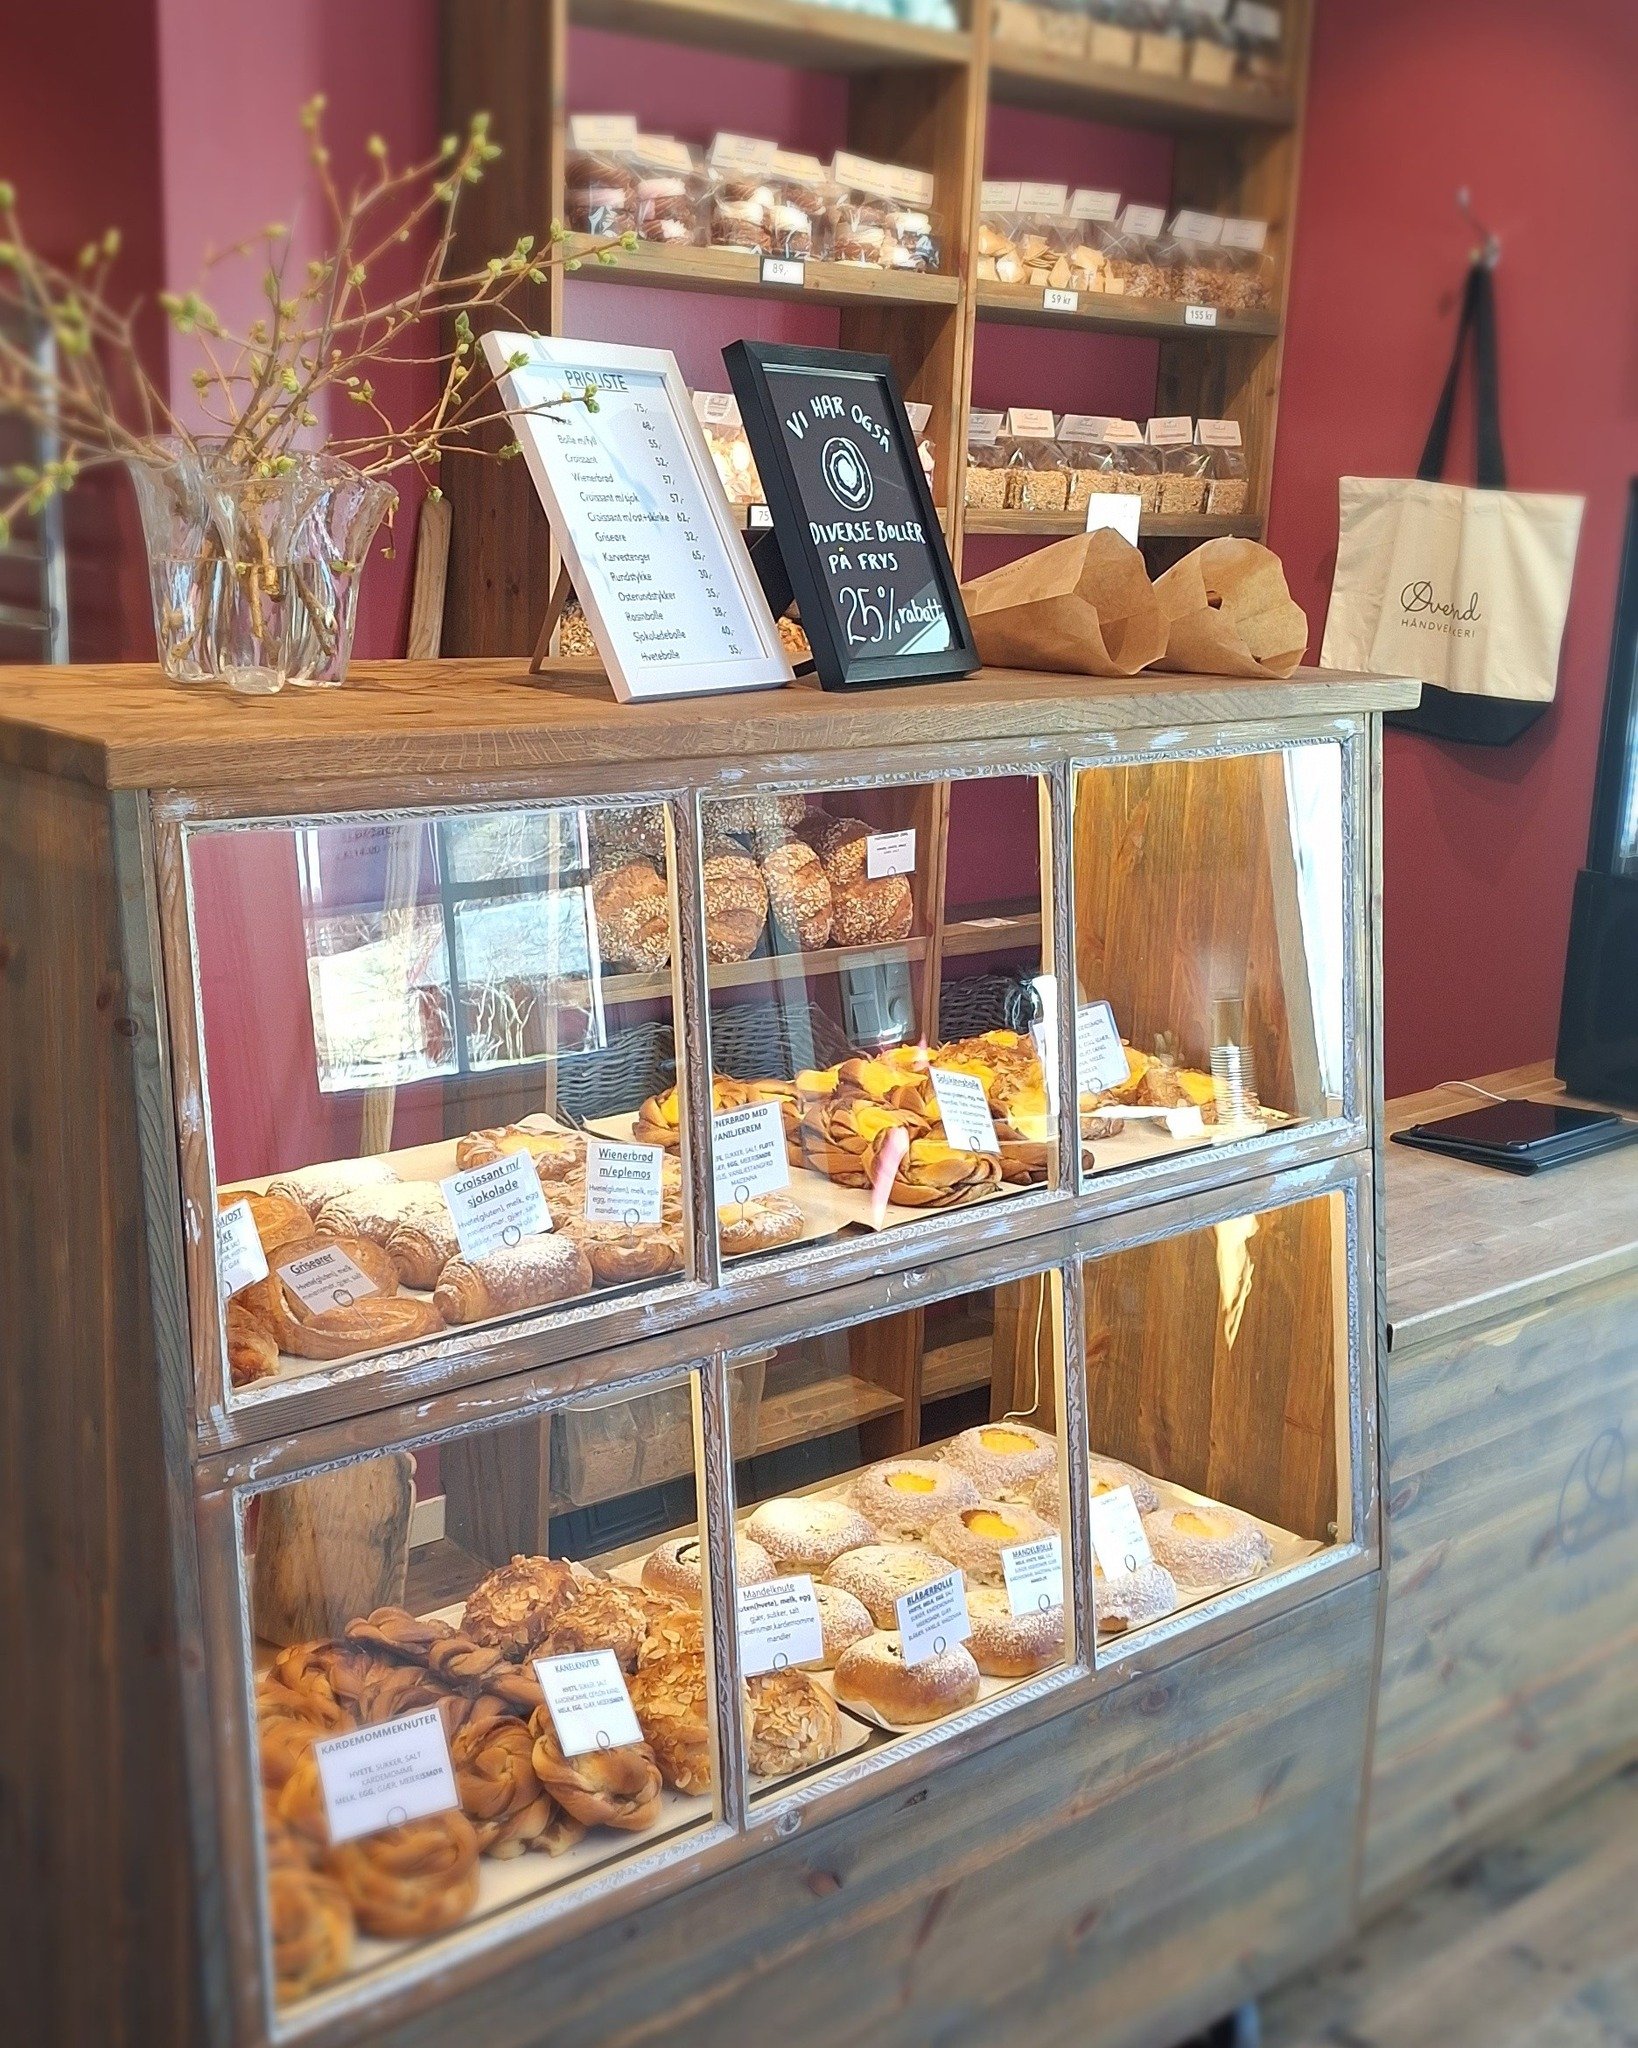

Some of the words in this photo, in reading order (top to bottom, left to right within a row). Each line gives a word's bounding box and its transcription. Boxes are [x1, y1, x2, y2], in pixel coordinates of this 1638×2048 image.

[1051, 293, 1061, 304] 59
[1062, 295, 1071, 305] kr
[1190, 310, 1204, 320] 155
[1205, 312, 1213, 320] kr
[565, 370, 628, 390] PRISLISTE
[786, 410, 809, 440] VI
[810, 394, 846, 420] HAR
[851, 404, 891, 453] OGSÅ
[809, 521, 875, 545] DIVERSE
[875, 520, 926, 544] BOLLER
[828, 546, 852, 574] PÅ
[857, 553, 899, 571] FRYS
[610, 571, 652, 583] Rundstykke
[618, 591, 676, 602] Osterundstykker
[840, 586, 901, 645] 25%
[898, 598, 944, 624] rabatt
[641, 649, 680, 662] Hvetebolle
[752, 1108, 768, 1118] MED
[598, 1148, 654, 1162] Wienerbrød
[454, 1166, 504, 1194] Croissant
[506, 1157, 520, 1174] m/
[599, 1166, 652, 1180] m/eplemos
[467, 1179, 519, 1208] sjokolade
[525, 1192, 539, 1202] egg
[743, 1583, 795, 1599] Mandelknute
[907, 1577, 953, 1606] BLÅBÆRBOLLE
[780, 1596, 797, 1604] melk,
[799, 1595, 812, 1603] egg
[555, 1659, 600, 1672] KANELKNUTER
[321, 1714, 437, 1755] KARDEMOMMEKNUTER
[361, 1765, 413, 1786] KARDEMOMME
